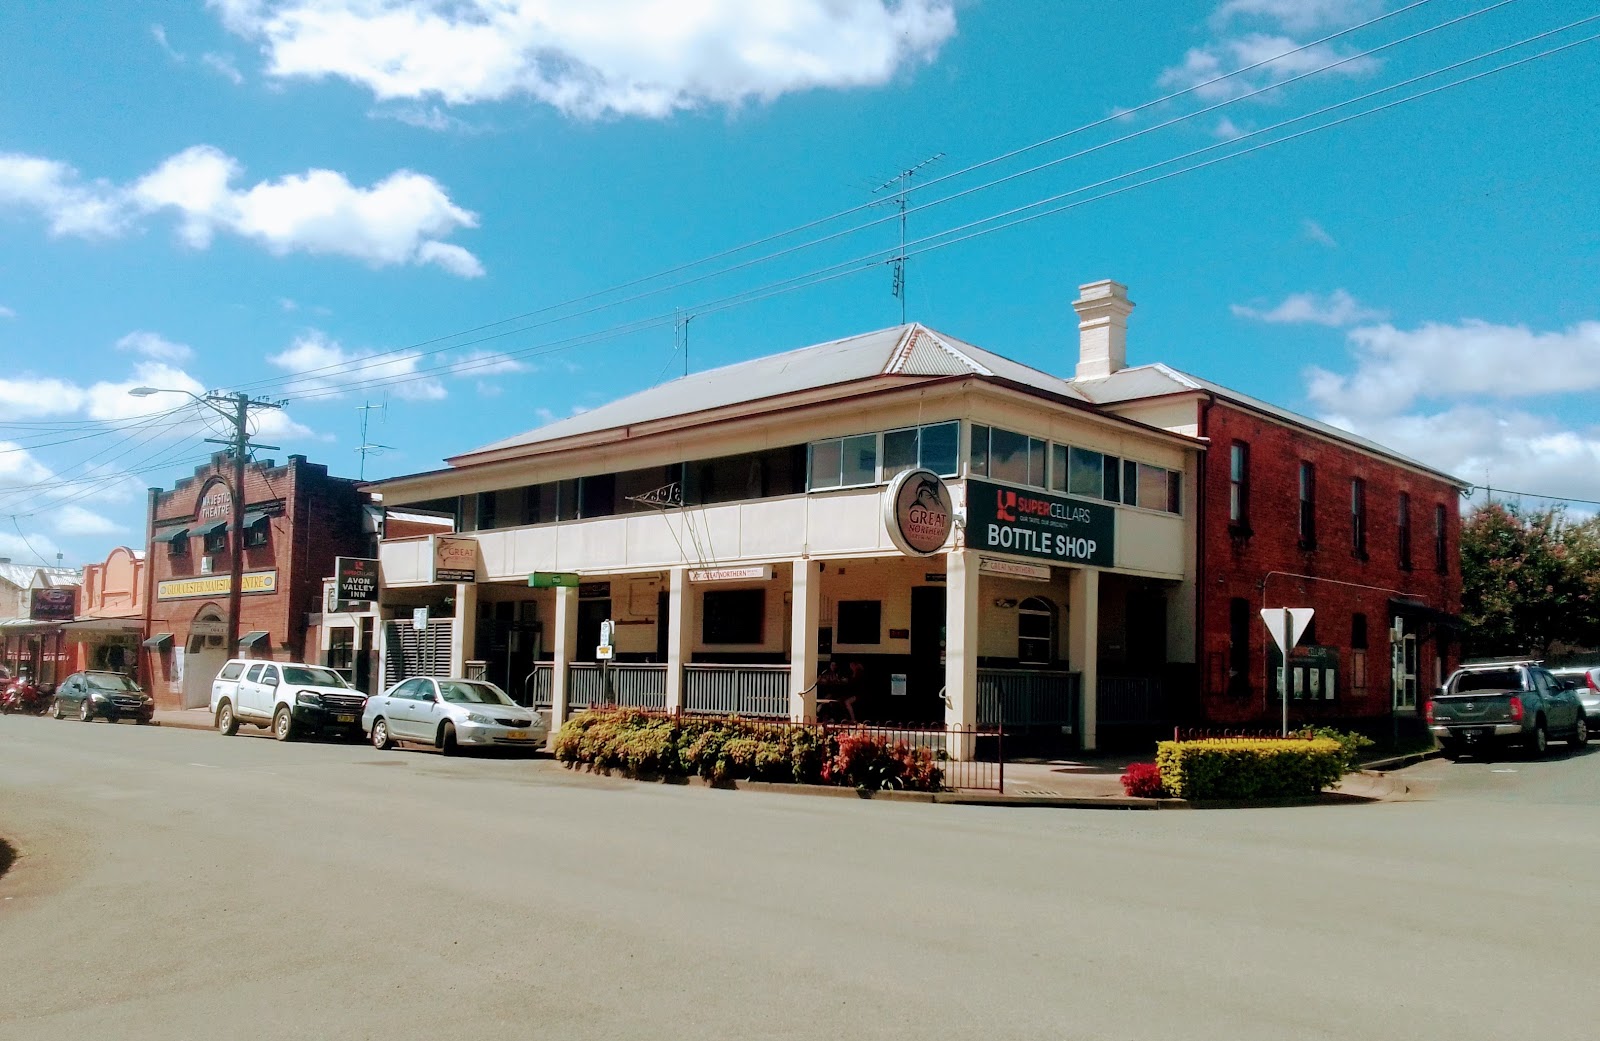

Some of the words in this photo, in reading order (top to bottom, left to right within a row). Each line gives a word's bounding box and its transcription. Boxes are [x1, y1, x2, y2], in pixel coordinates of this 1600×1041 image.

[202, 505, 230, 519] THEATRE
[1018, 497, 1090, 524] SUPERCELLARS
[909, 509, 947, 528] GREAT
[909, 524, 945, 537] NORTHERN
[987, 523, 1052, 555] BOTTLE
[1055, 534, 1097, 560] SHOP
[449, 548, 474, 557] GREAT
[720, 570, 747, 578] NORTHERN
[167, 581, 204, 595] GLOUCESTER
[243, 576, 263, 589] ENTRE
[342, 583, 374, 592] VALLEY
[346, 577, 370, 585] AVON
